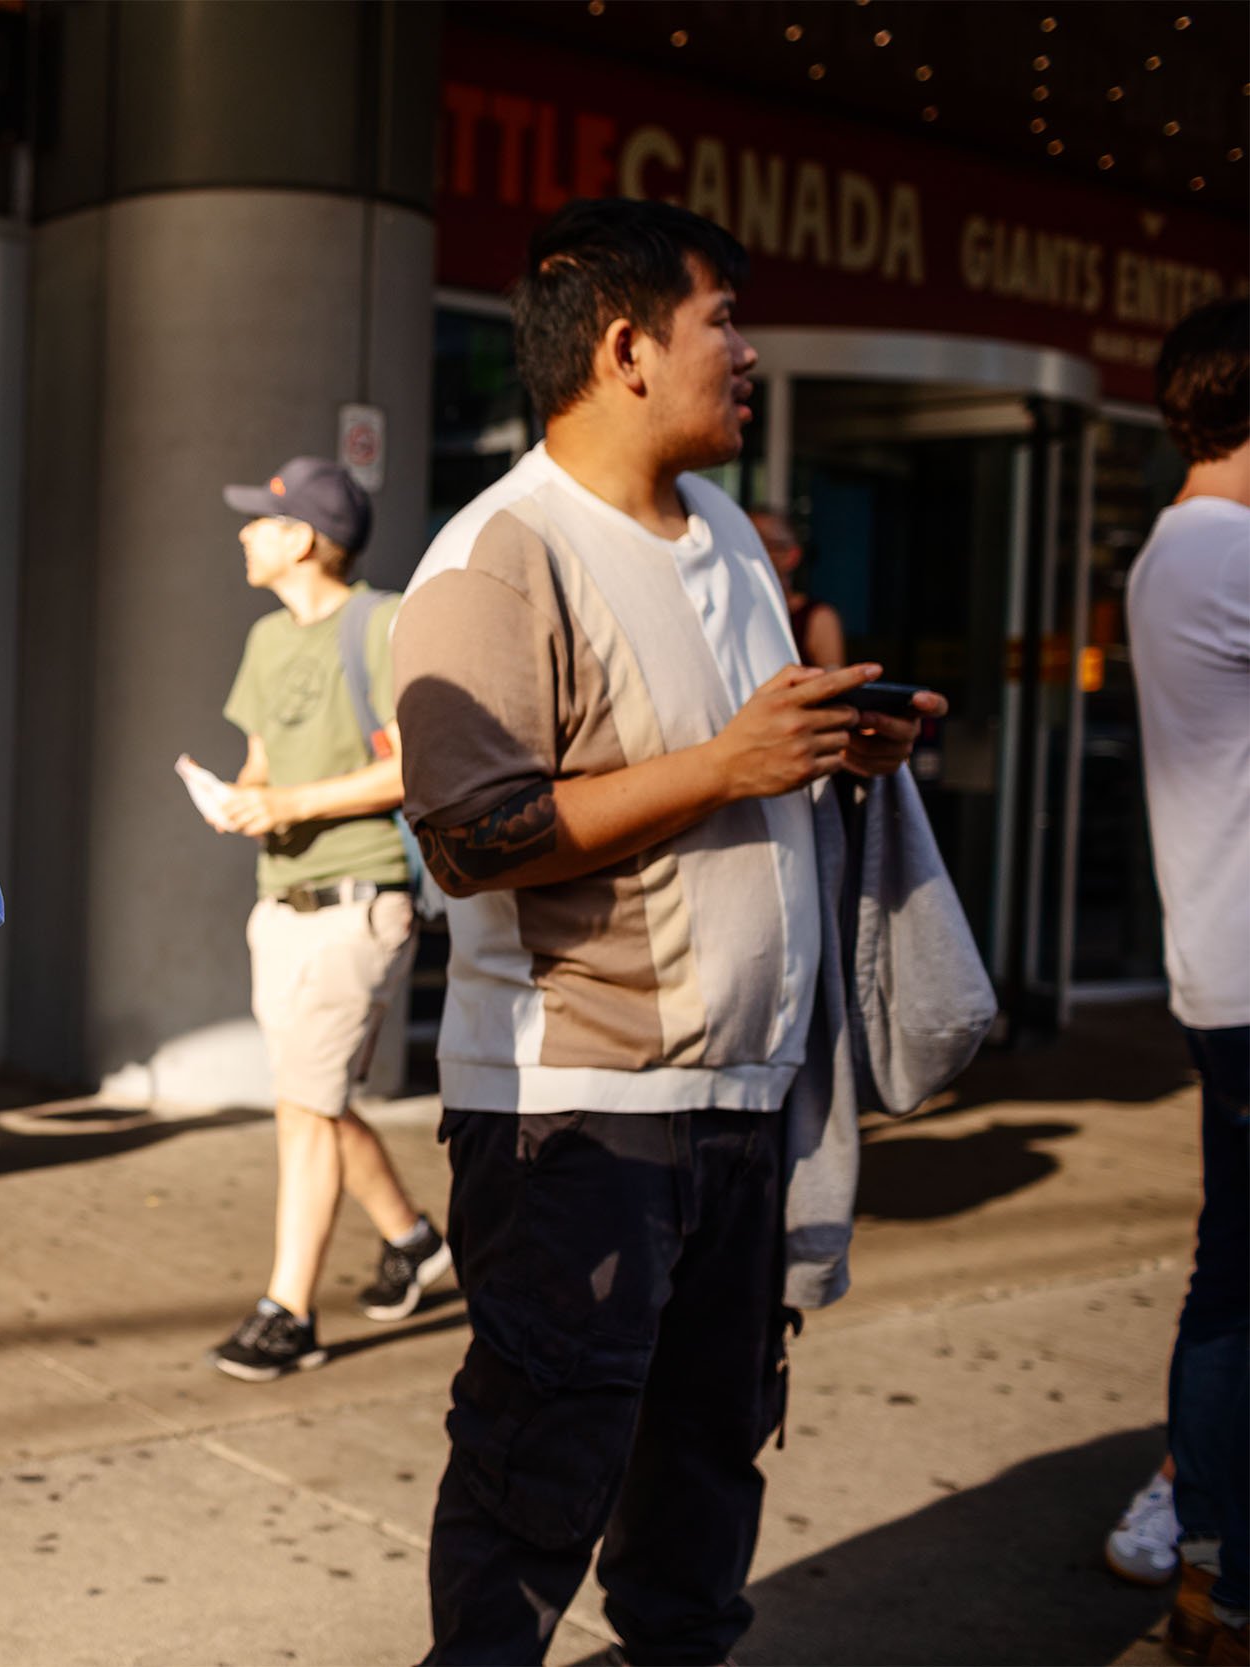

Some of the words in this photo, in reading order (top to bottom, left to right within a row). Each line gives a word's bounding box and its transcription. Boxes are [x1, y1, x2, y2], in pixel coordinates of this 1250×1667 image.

[439, 80, 618, 213] TTLE
[618, 122, 926, 289] CANADA
[961, 212, 1103, 316] GIANTS
